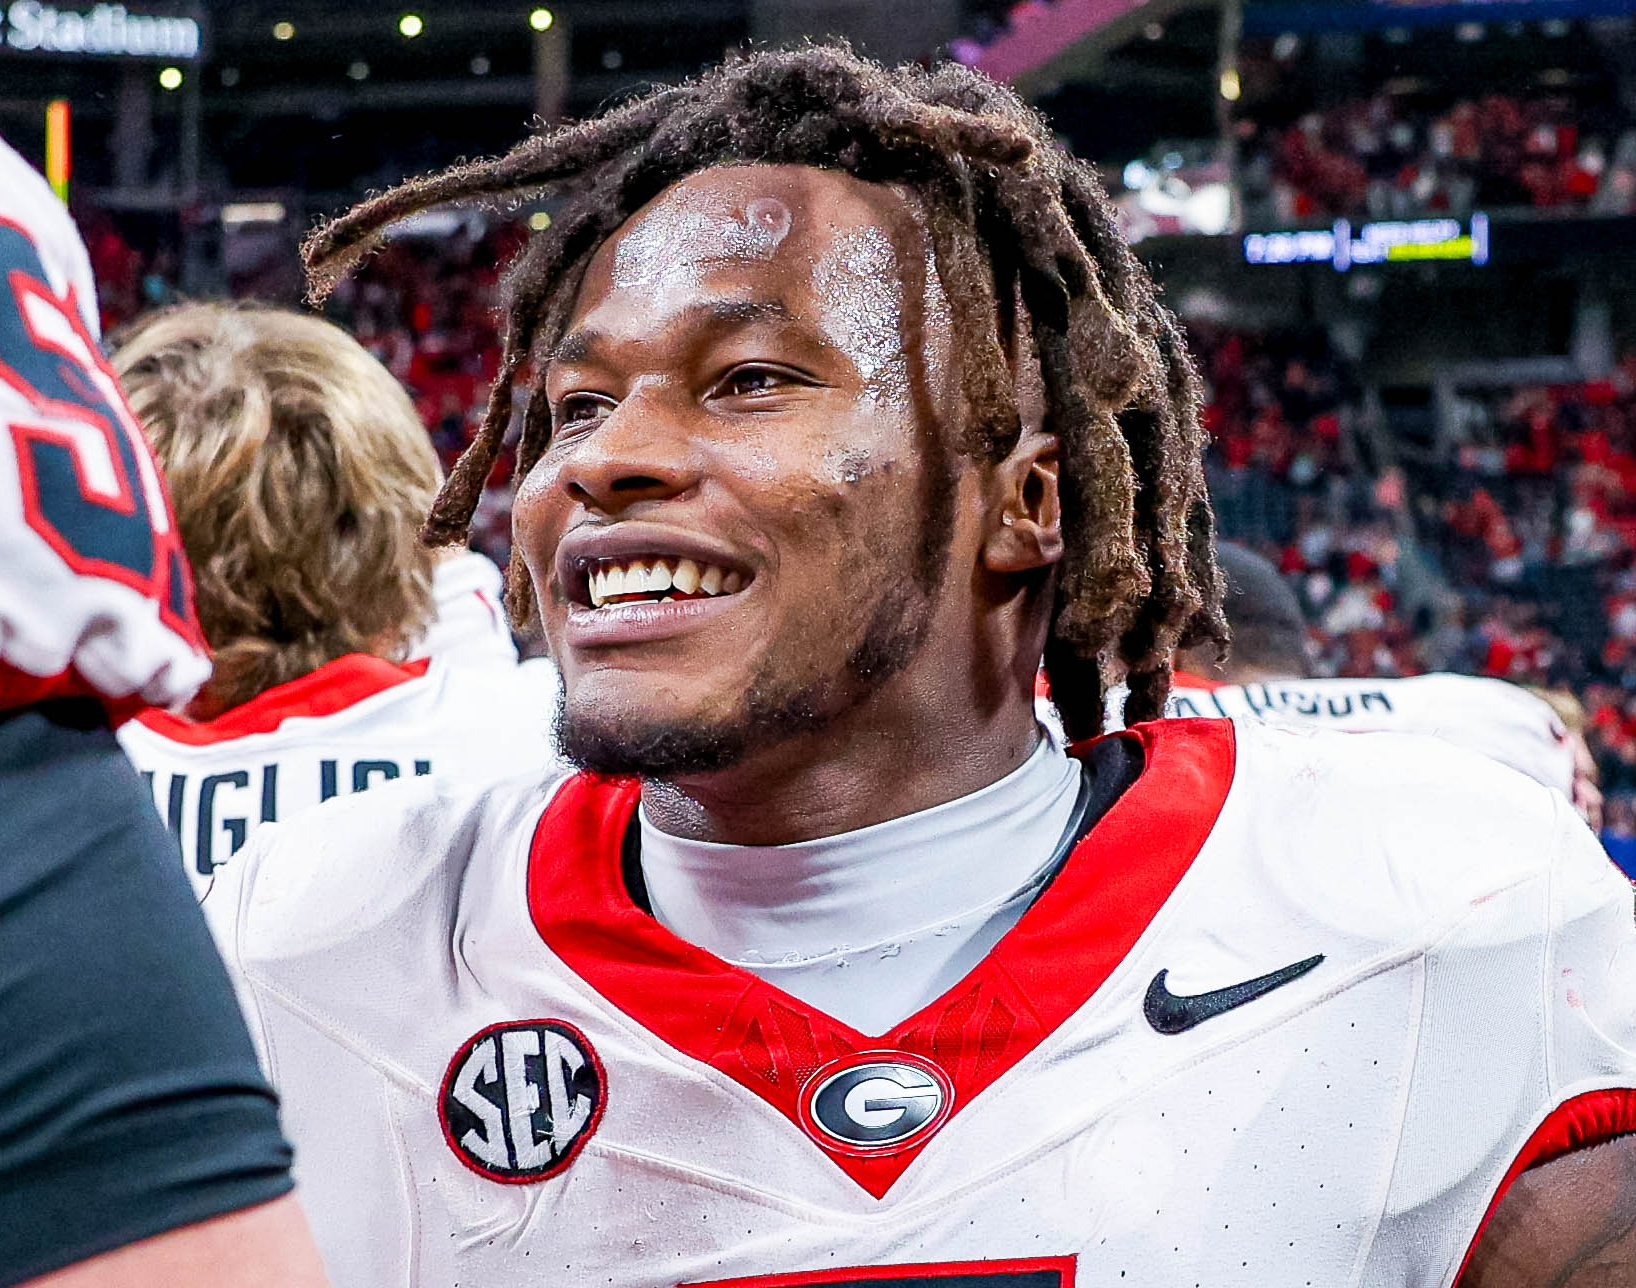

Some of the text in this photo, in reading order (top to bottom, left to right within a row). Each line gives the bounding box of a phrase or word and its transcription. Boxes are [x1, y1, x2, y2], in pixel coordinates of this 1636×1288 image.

[7, 0, 200, 58] Stadium
[452, 1029, 593, 1171] SEC
[814, 1064, 939, 1142] G
